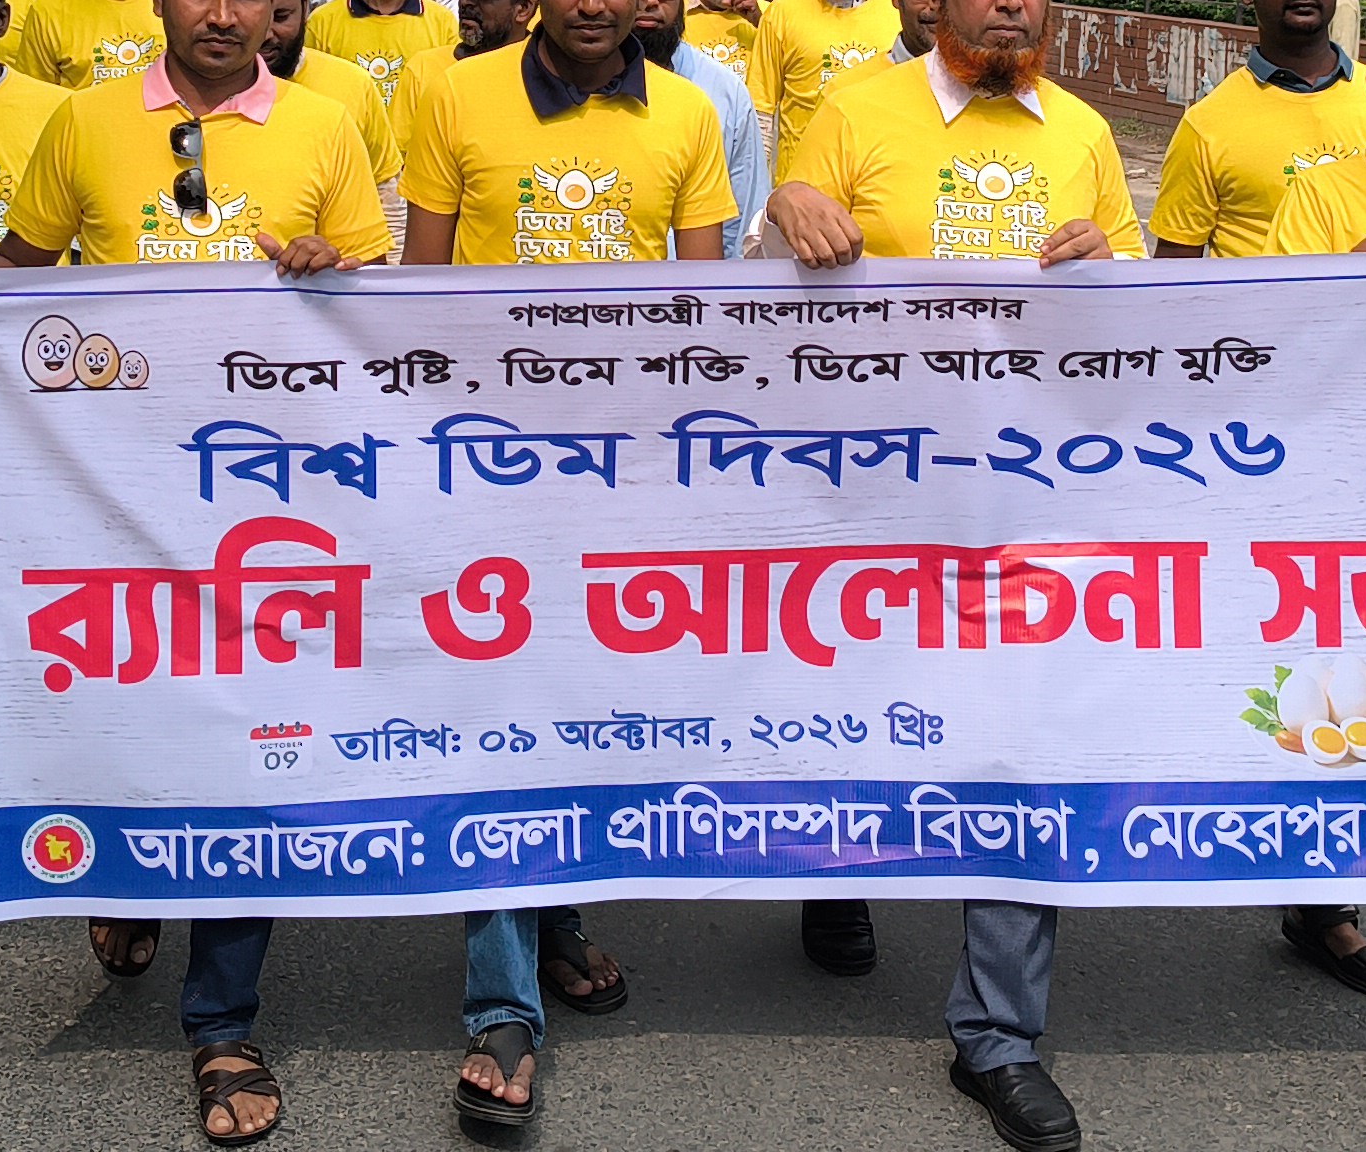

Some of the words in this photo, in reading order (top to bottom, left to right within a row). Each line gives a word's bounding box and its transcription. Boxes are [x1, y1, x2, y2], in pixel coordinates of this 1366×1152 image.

[514, 205, 575, 232] ডিমে
[580, 208, 635, 240] পুষ্টি,
[934, 195, 995, 222] ডিমে
[1000, 200, 1056, 231] পুষ্টি,
[135, 233, 200, 260] ডিমে
[512, 231, 573, 258] ডিমে
[930, 218, 993, 247] ডিমে
[508, 294, 709, 328] গণপ্রজাতন্ত্রী
[719, 297, 896, 326] বাংলাদেশ
[904, 296, 1029, 322] সরকার
[217, 350, 347, 394] ডিমে
[496, 347, 620, 387] ডিমে
[787, 343, 910, 384] ডিমে
[919, 346, 1045, 382] আছে
[1058, 345, 1163, 380] রোগ
[1175, 336, 1277, 384] মুক্তি
[177, 419, 399, 504] বিশ্ব
[417, 412, 637, 496] ডিম
[657, 409, 1286, 490] দিবস-২০২৬
[421, 556, 532, 661] ও
[581, 541, 1209, 668] আলোচনা
[259, 741, 303, 750] OCTOBER
[330, 717, 461, 762] তারিখ:
[478, 722, 537, 753] ০৯
[551, 708, 732, 753] অক্টোবর,
[749, 713, 868, 750] ২০২৬
[264, 750, 299, 771] 09
[119, 819, 425, 880] আয়োজনে:
[449, 801, 592, 868] জেলা
[606, 783, 894, 861] প্রাণিসম্পদ
